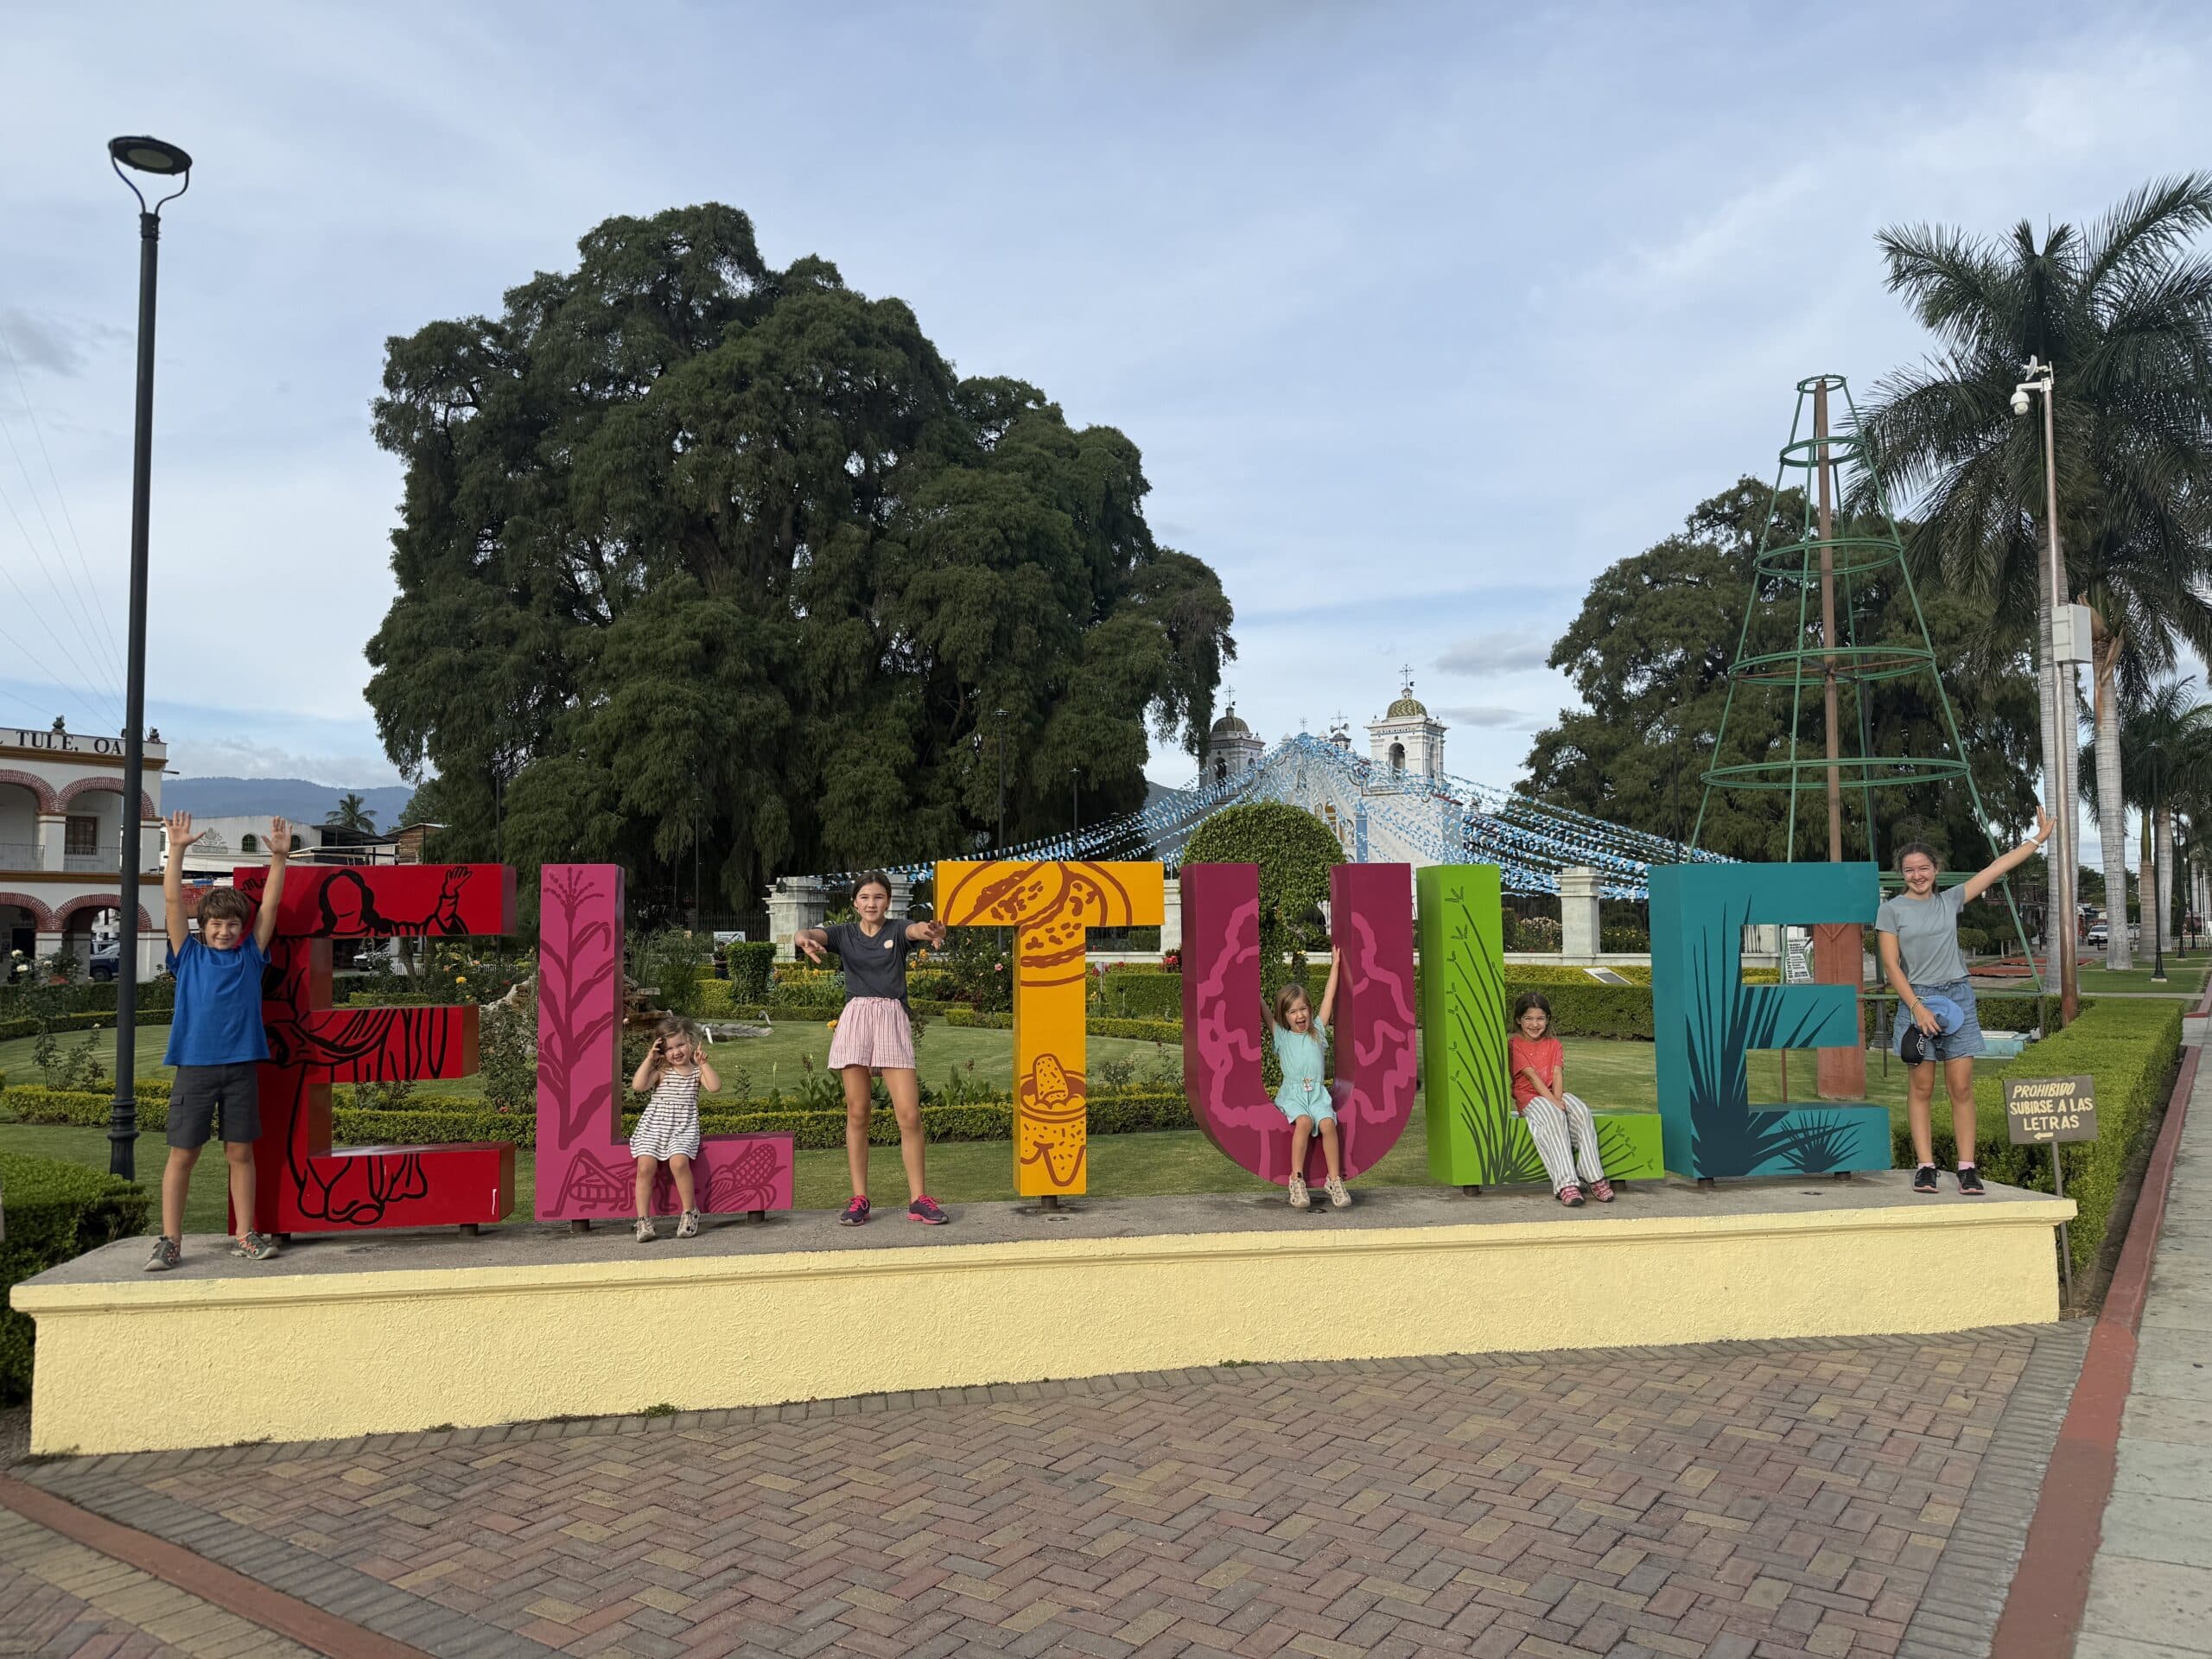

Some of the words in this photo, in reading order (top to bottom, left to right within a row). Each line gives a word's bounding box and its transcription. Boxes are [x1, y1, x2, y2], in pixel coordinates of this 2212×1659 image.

[16, 731, 79, 752] TULE,
[228, 864, 796, 1236] EL
[933, 861, 1891, 1196] TULE
[2012, 1082, 2075, 1099] PROHIBIDO
[2009, 1099, 2054, 1116] SUBIRSE
[2057, 1098, 2067, 1113] A
[2069, 1097, 2094, 1112] LAS
[2023, 1115, 2080, 1131] LETRAS
